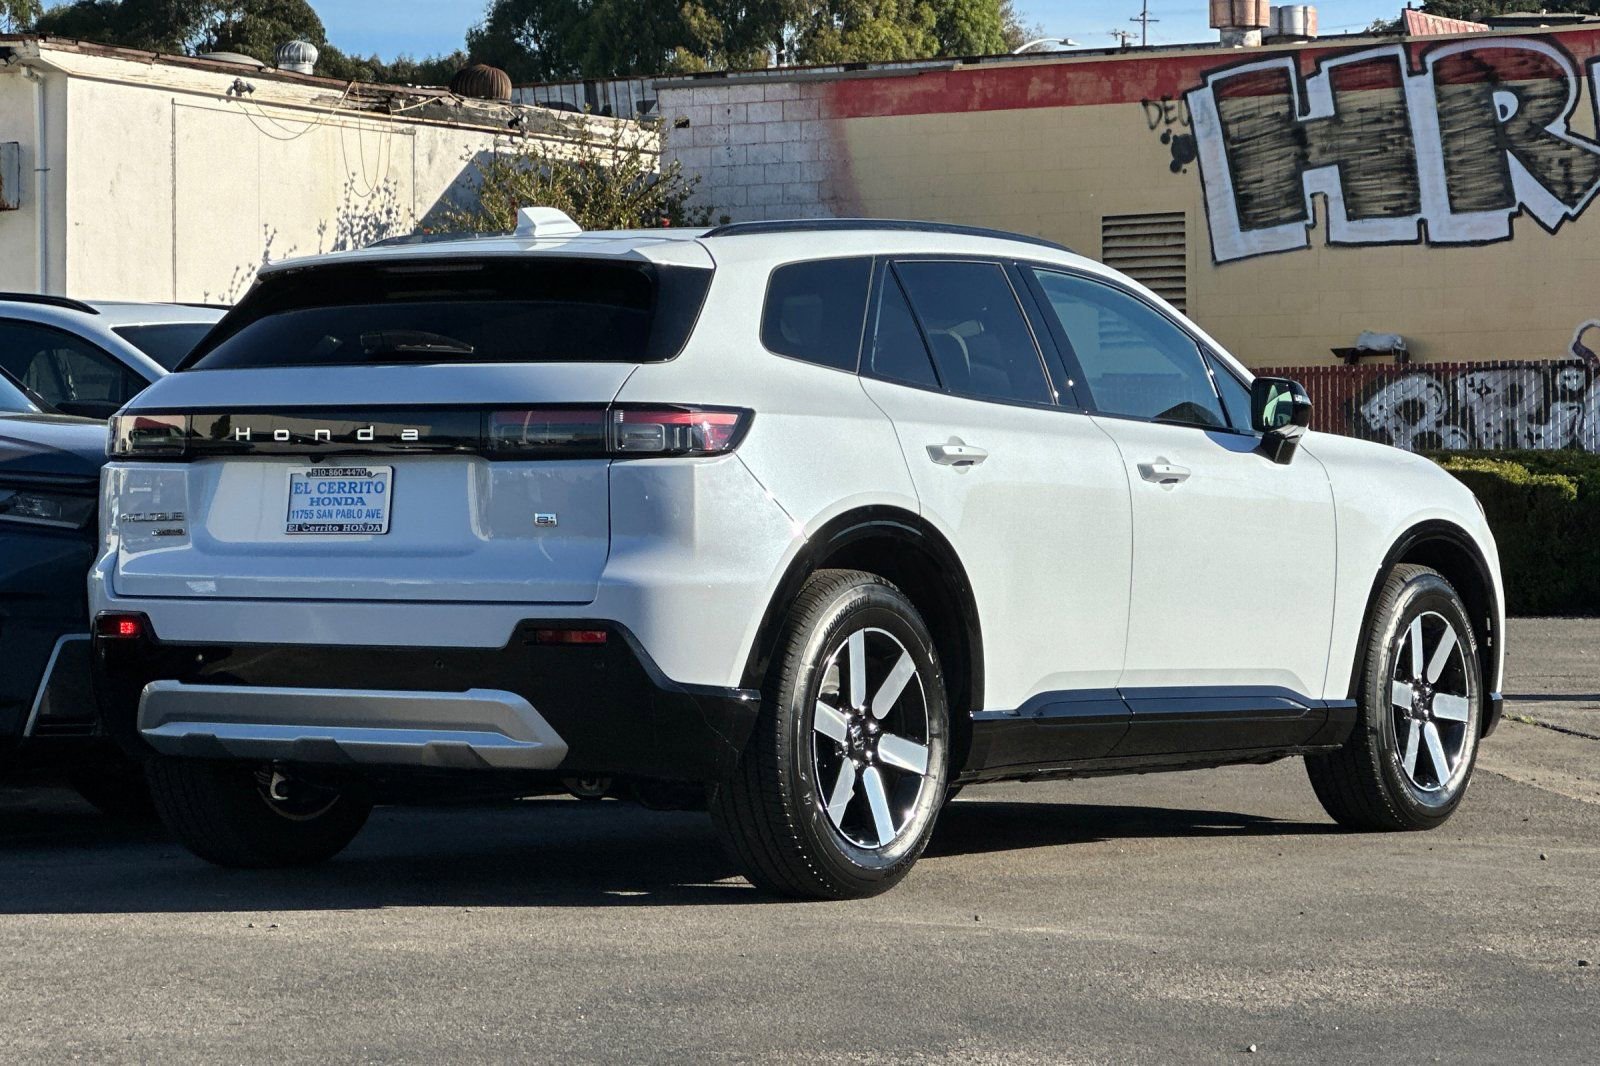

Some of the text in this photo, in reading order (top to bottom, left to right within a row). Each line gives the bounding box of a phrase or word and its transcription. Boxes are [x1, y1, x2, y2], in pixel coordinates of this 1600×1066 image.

[235, 425, 419, 441] Honda
[294, 481, 385, 494] EL CERRITO
[309, 496, 367, 506] HONDA
[291, 509, 384, 519] 11755 SAN PABLO AVE.
